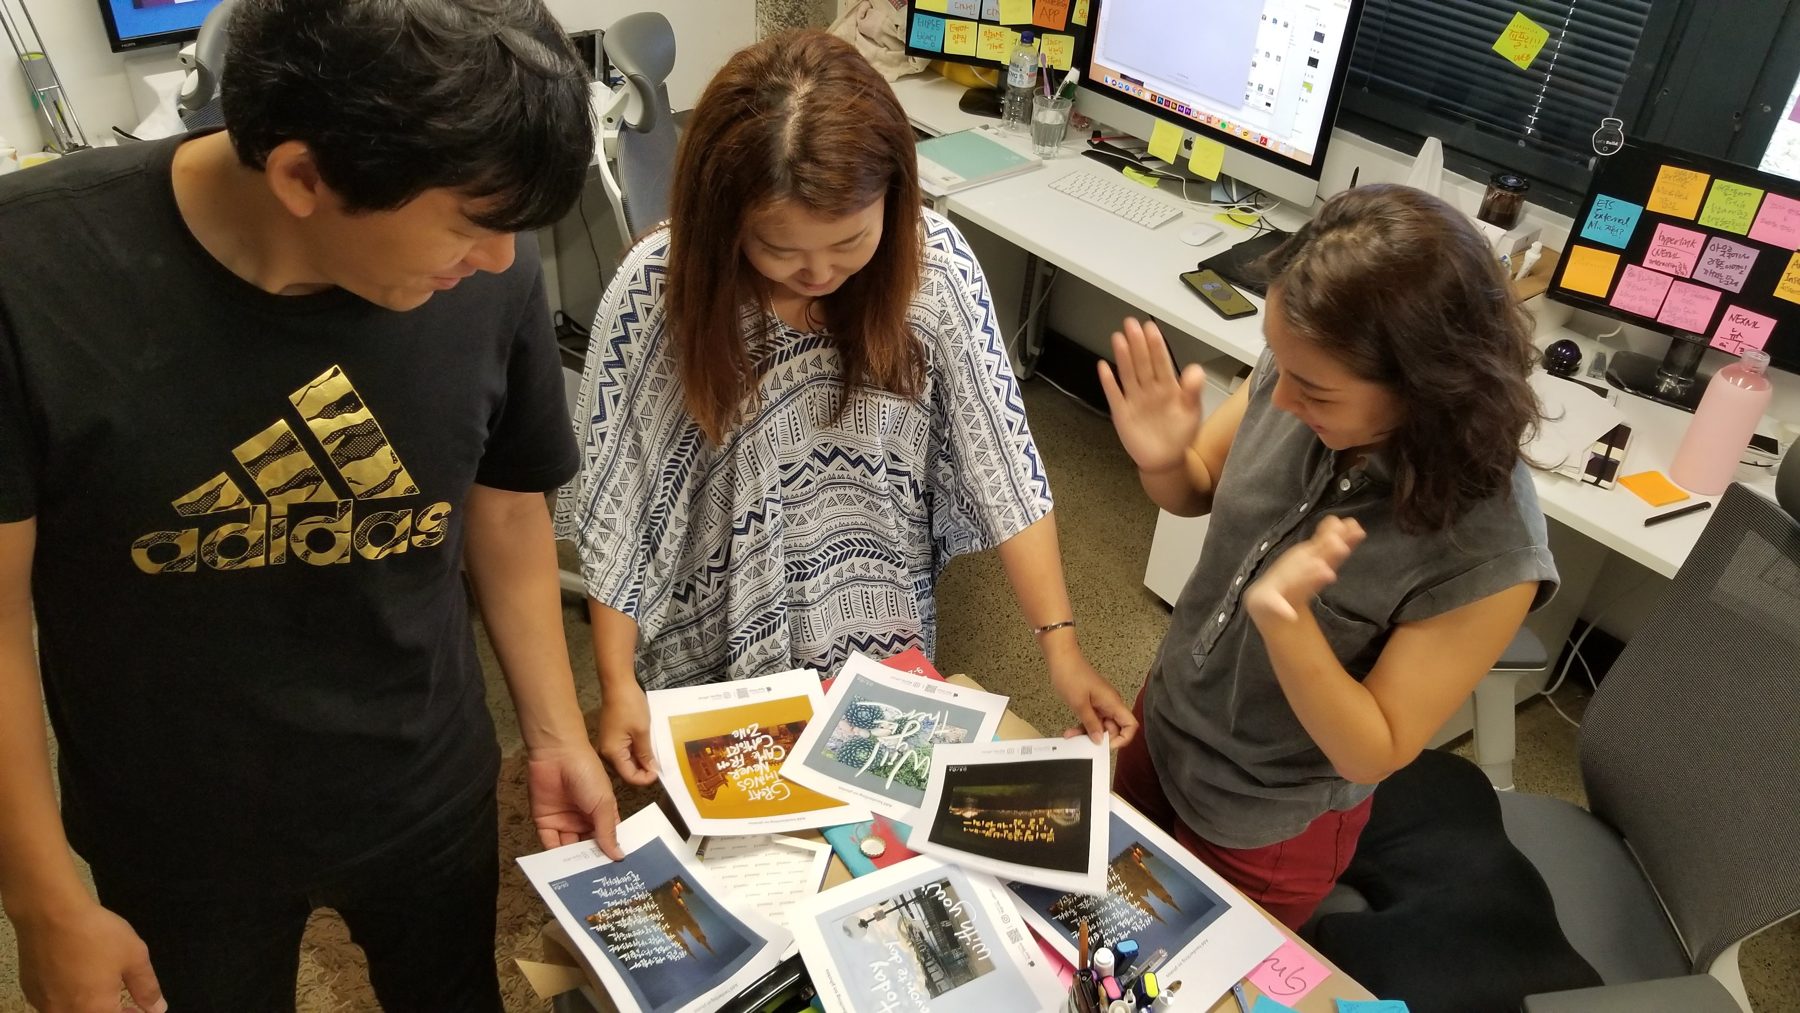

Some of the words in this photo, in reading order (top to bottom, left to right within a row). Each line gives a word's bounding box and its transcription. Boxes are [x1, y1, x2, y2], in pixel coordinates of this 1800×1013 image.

[1594, 208, 1630, 227] External
[1597, 199, 1615, 210] ETS
[1658, 231, 1697, 248] hyperlink
[131, 498, 453, 575] adidas
[855, 740, 931, 790] Will
[884, 939, 903, 965] day
[953, 919, 993, 961] with
[897, 967, 931, 1013] avorite
